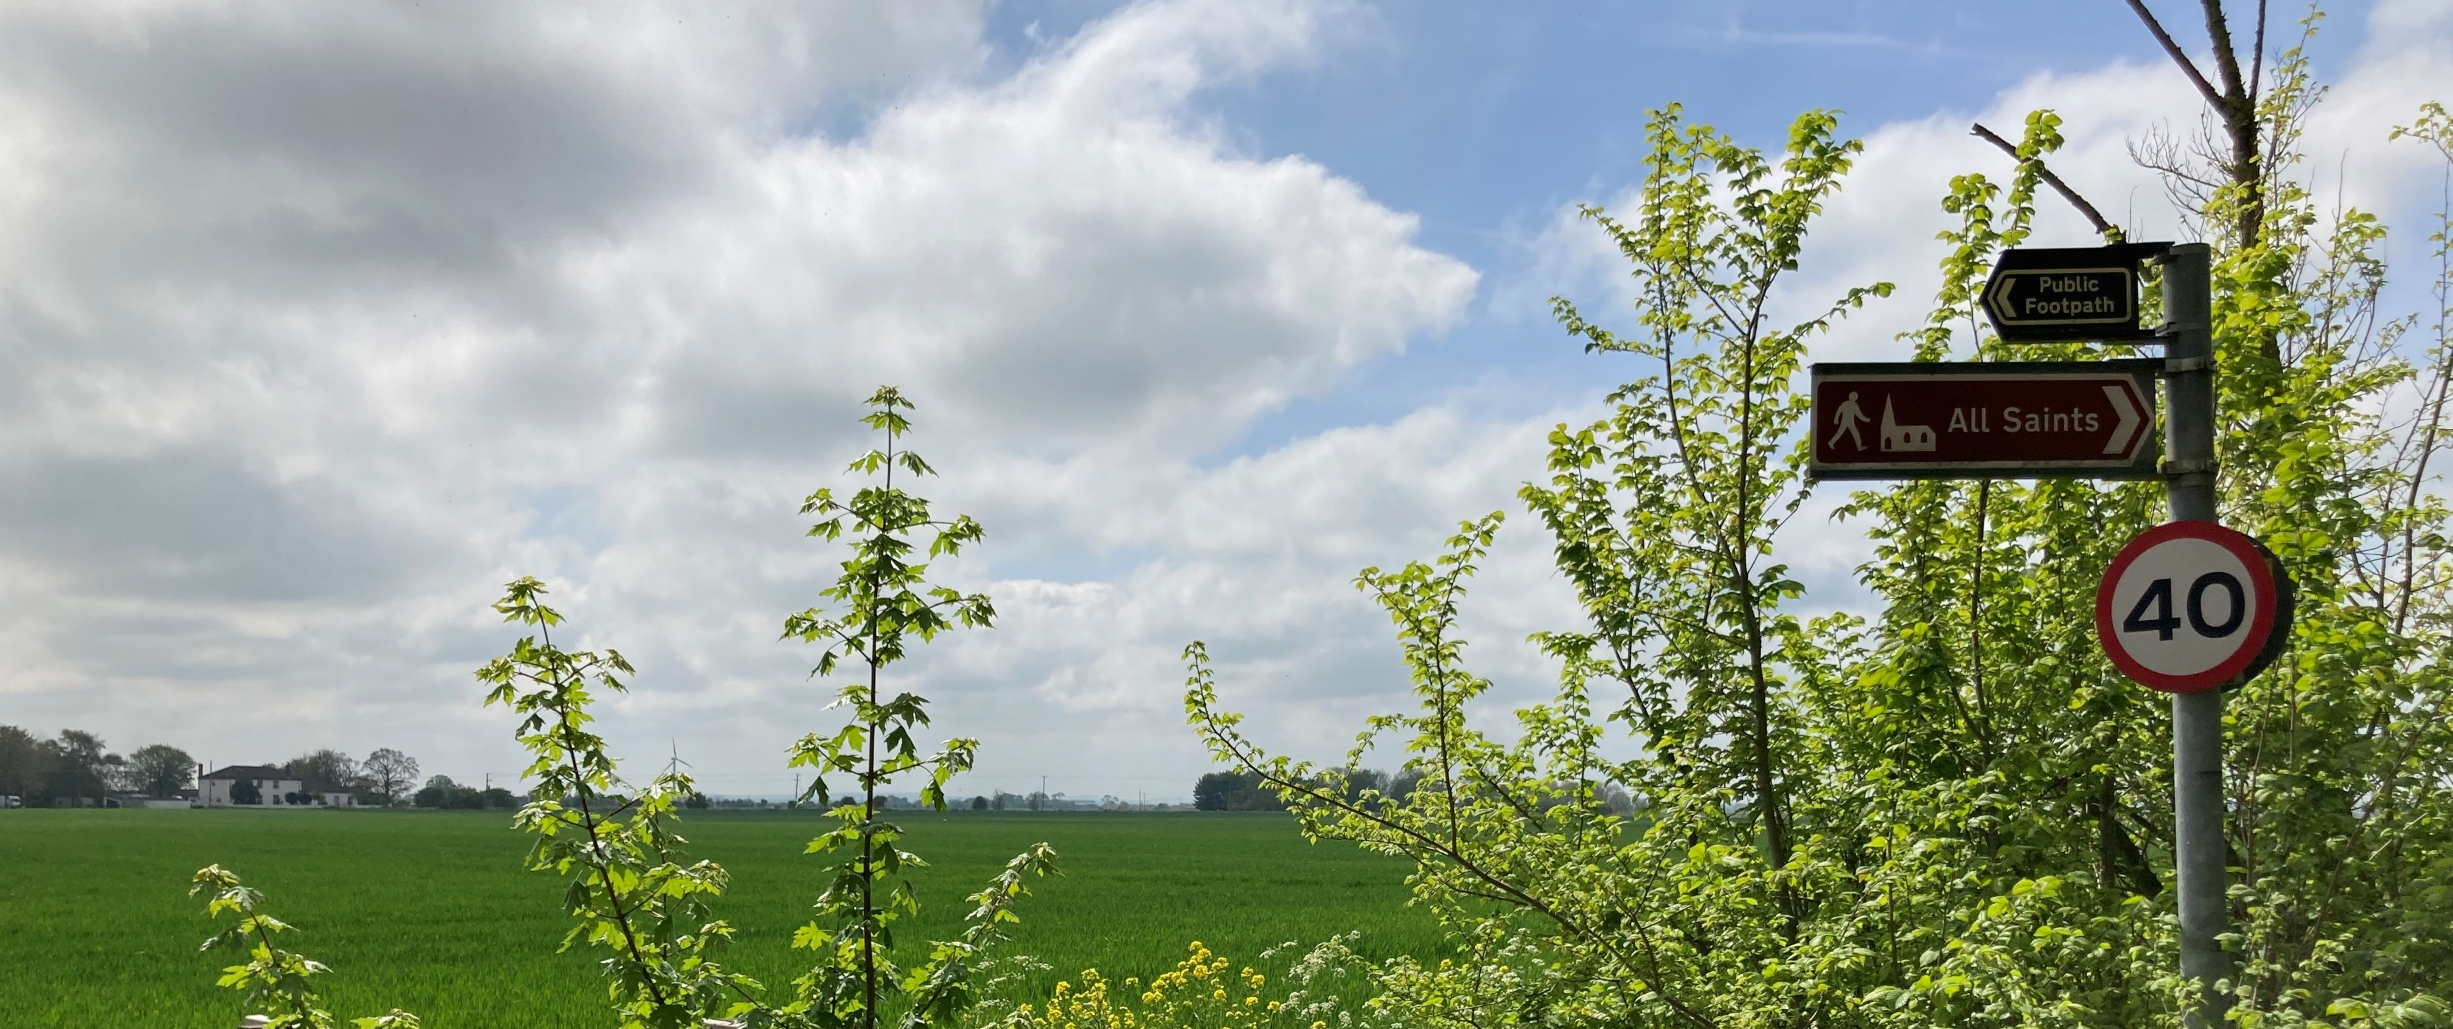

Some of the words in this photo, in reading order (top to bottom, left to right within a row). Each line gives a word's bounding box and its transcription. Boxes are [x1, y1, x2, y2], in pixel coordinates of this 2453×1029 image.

[2039, 276, 2100, 293] Public
[2025, 296, 2115, 316] Footpath
[1948, 407, 1990, 433] All
[2003, 406, 2099, 433] Saints
[2123, 571, 2246, 641] 40
